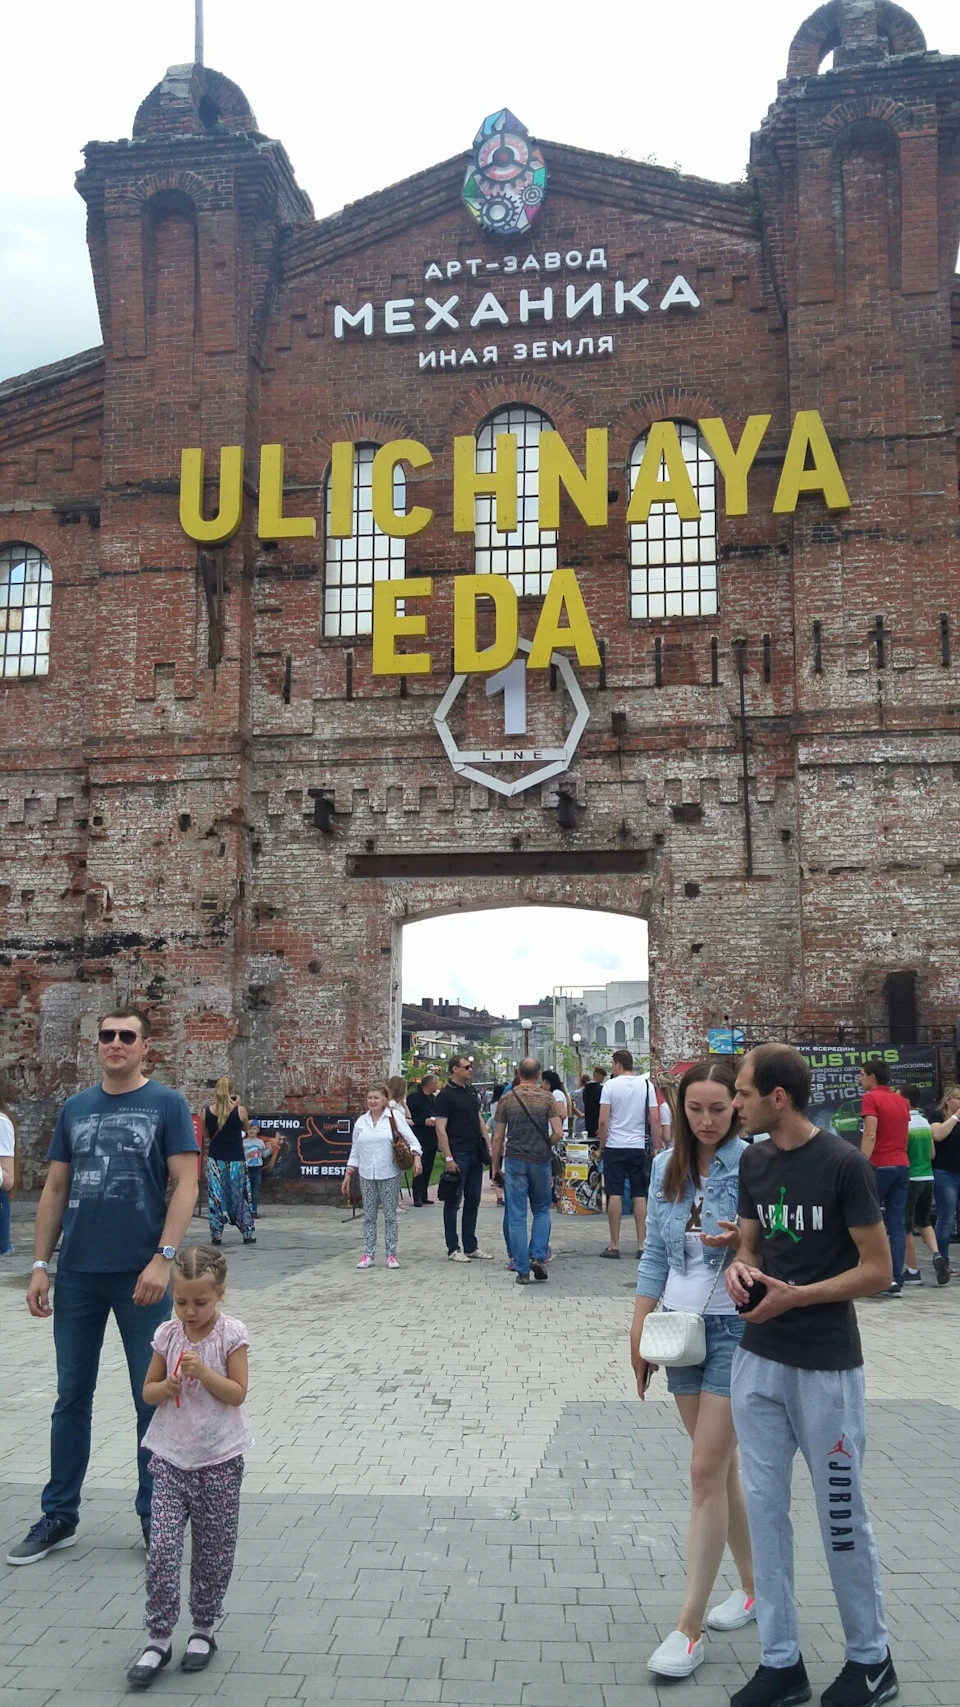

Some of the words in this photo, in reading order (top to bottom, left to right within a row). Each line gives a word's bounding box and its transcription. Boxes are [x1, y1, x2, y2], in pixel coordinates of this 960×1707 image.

[425, 248, 608, 281] АРТ-ЗАВОД
[334, 274, 701, 339] МЕХАНИКА
[418, 345, 499, 370] ИНАЯ
[513, 335, 615, 361] ЗЕМЛЯ
[179, 410, 851, 543] ULICHNAYA
[372, 568, 602, 675] EDA
[485, 658, 526, 736] 1
[482, 751, 543, 760] LINE
[301, 1166, 319, 1175] THE
[828, 1461, 855, 1552] JORDAN
